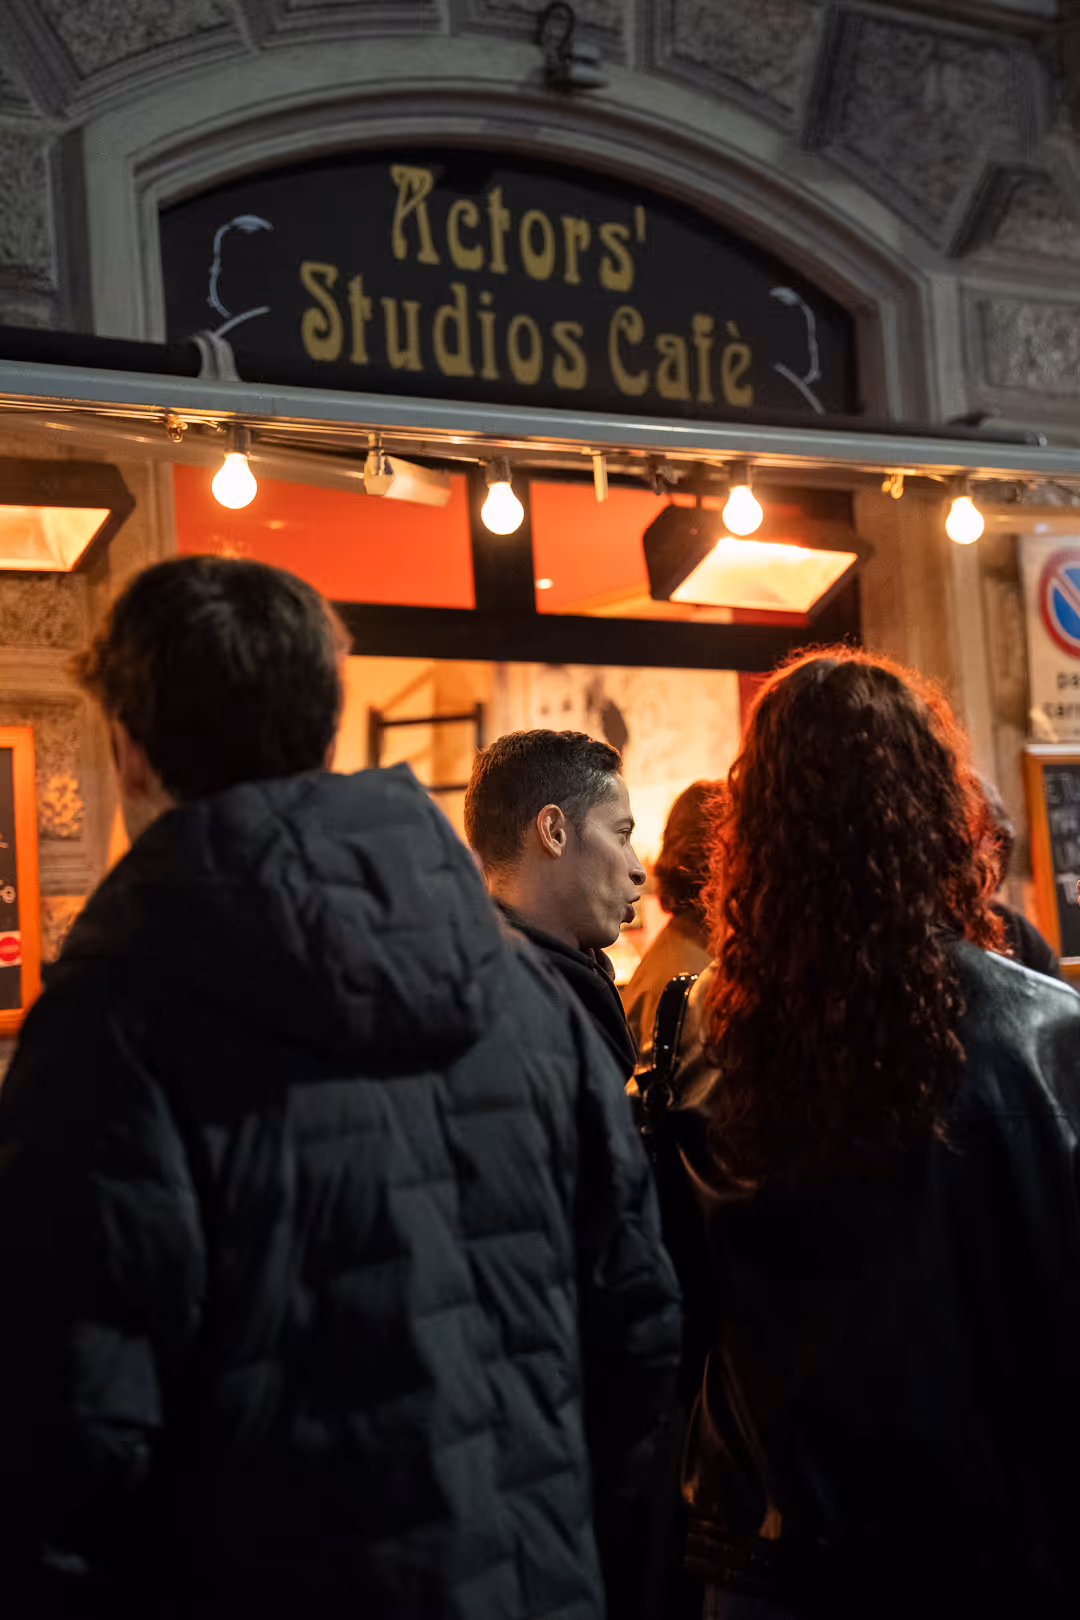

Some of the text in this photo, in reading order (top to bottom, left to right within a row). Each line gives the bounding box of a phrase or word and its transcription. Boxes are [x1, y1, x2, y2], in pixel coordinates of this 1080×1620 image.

[391, 164, 647, 291] Actors'
[300, 261, 754, 408] Studios Cafè
